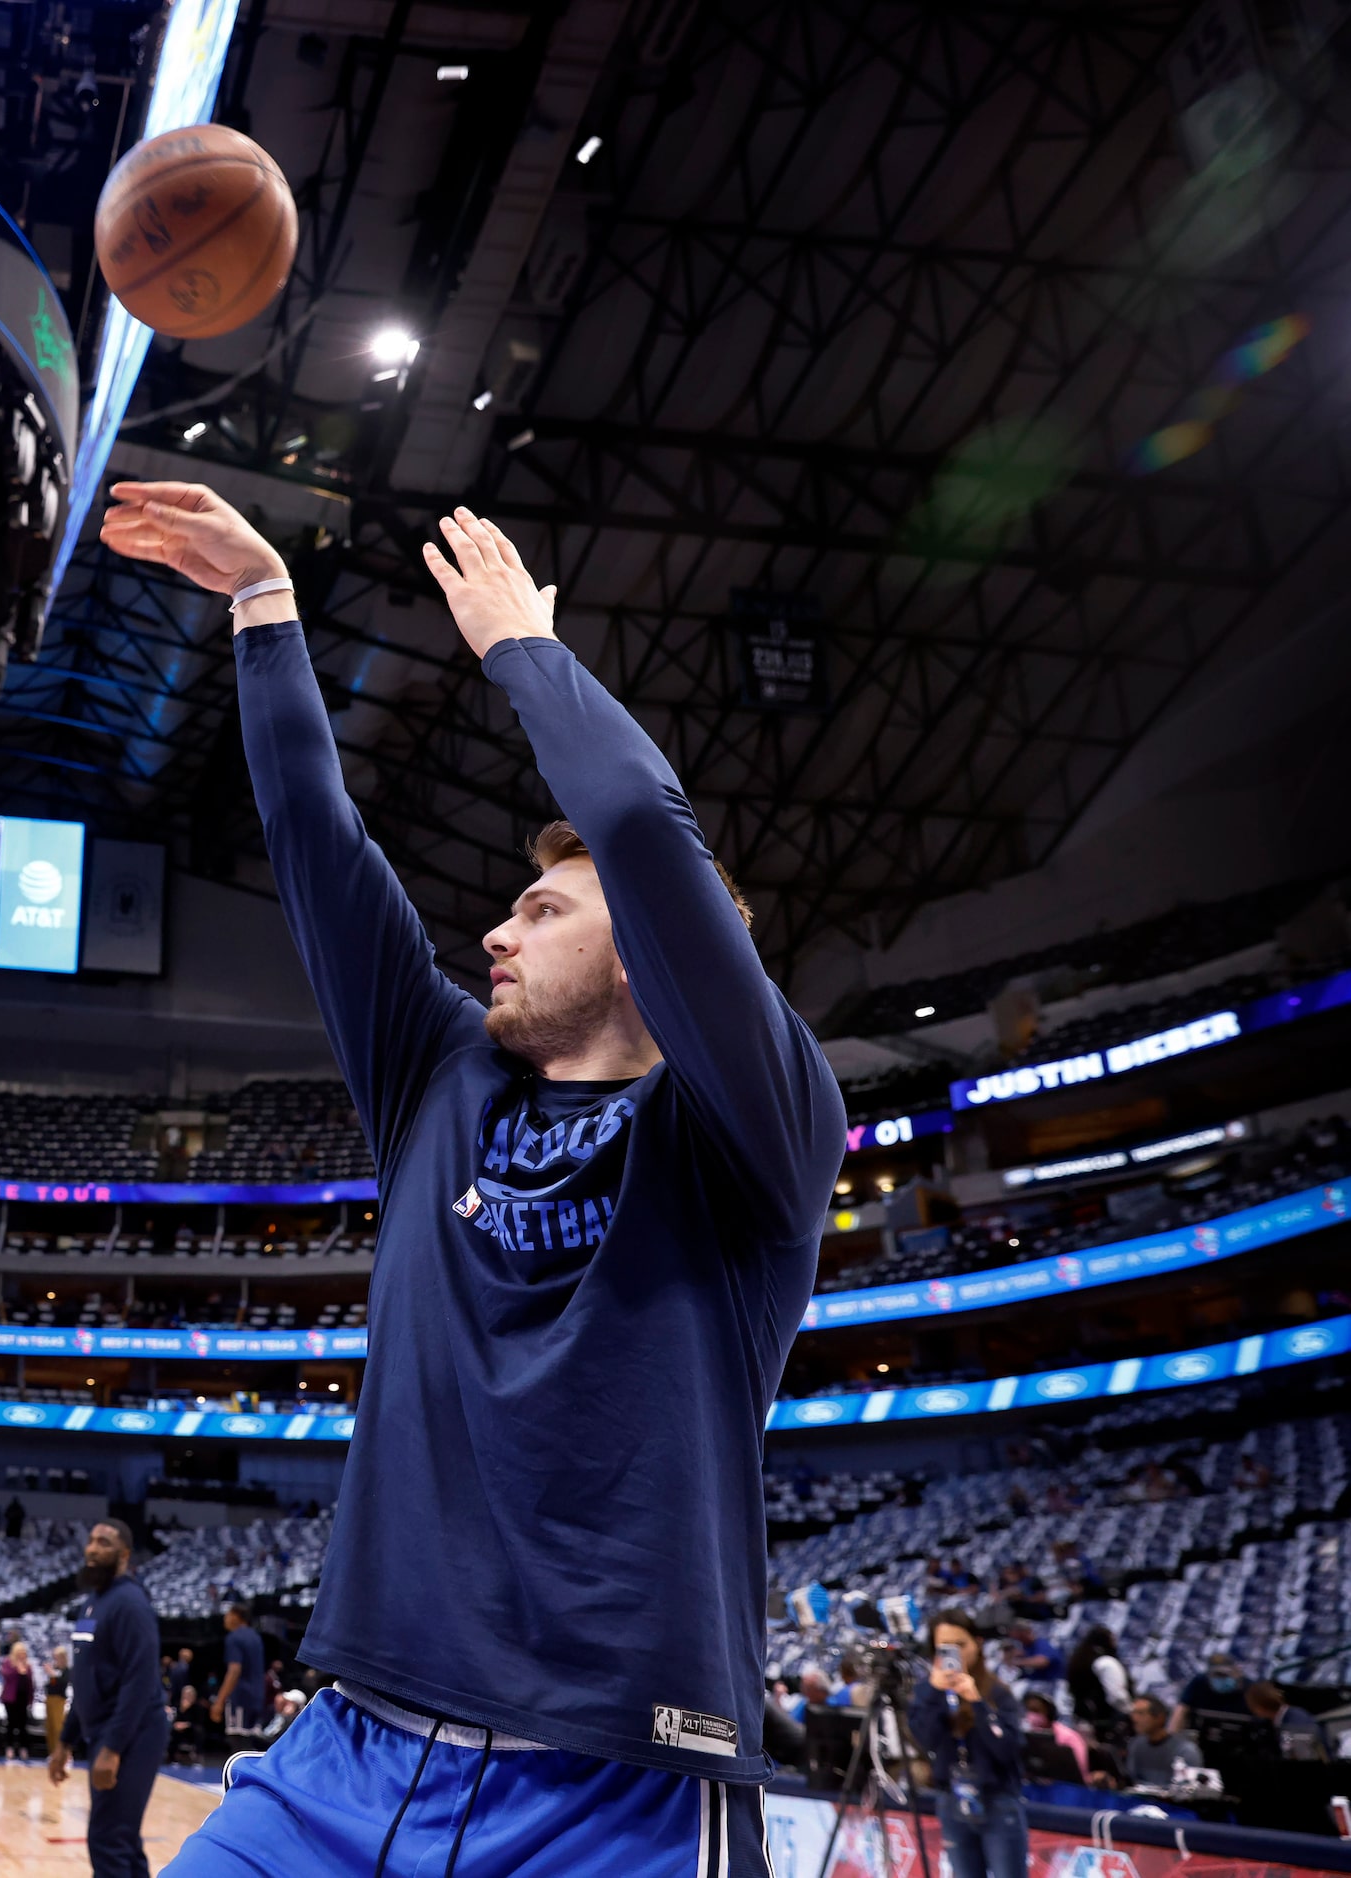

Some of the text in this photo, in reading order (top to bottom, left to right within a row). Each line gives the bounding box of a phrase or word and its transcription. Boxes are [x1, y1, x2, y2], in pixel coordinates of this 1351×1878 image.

[10, 905, 65, 928] AT&T
[966, 1011, 1241, 1104] JUSTIN BIEBER
[875, 1116, 913, 1146] 01
[36, 1184, 111, 1202] TOUR
[29, 1335, 65, 1348] TEXAS
[683, 1718, 700, 1730] XLT
